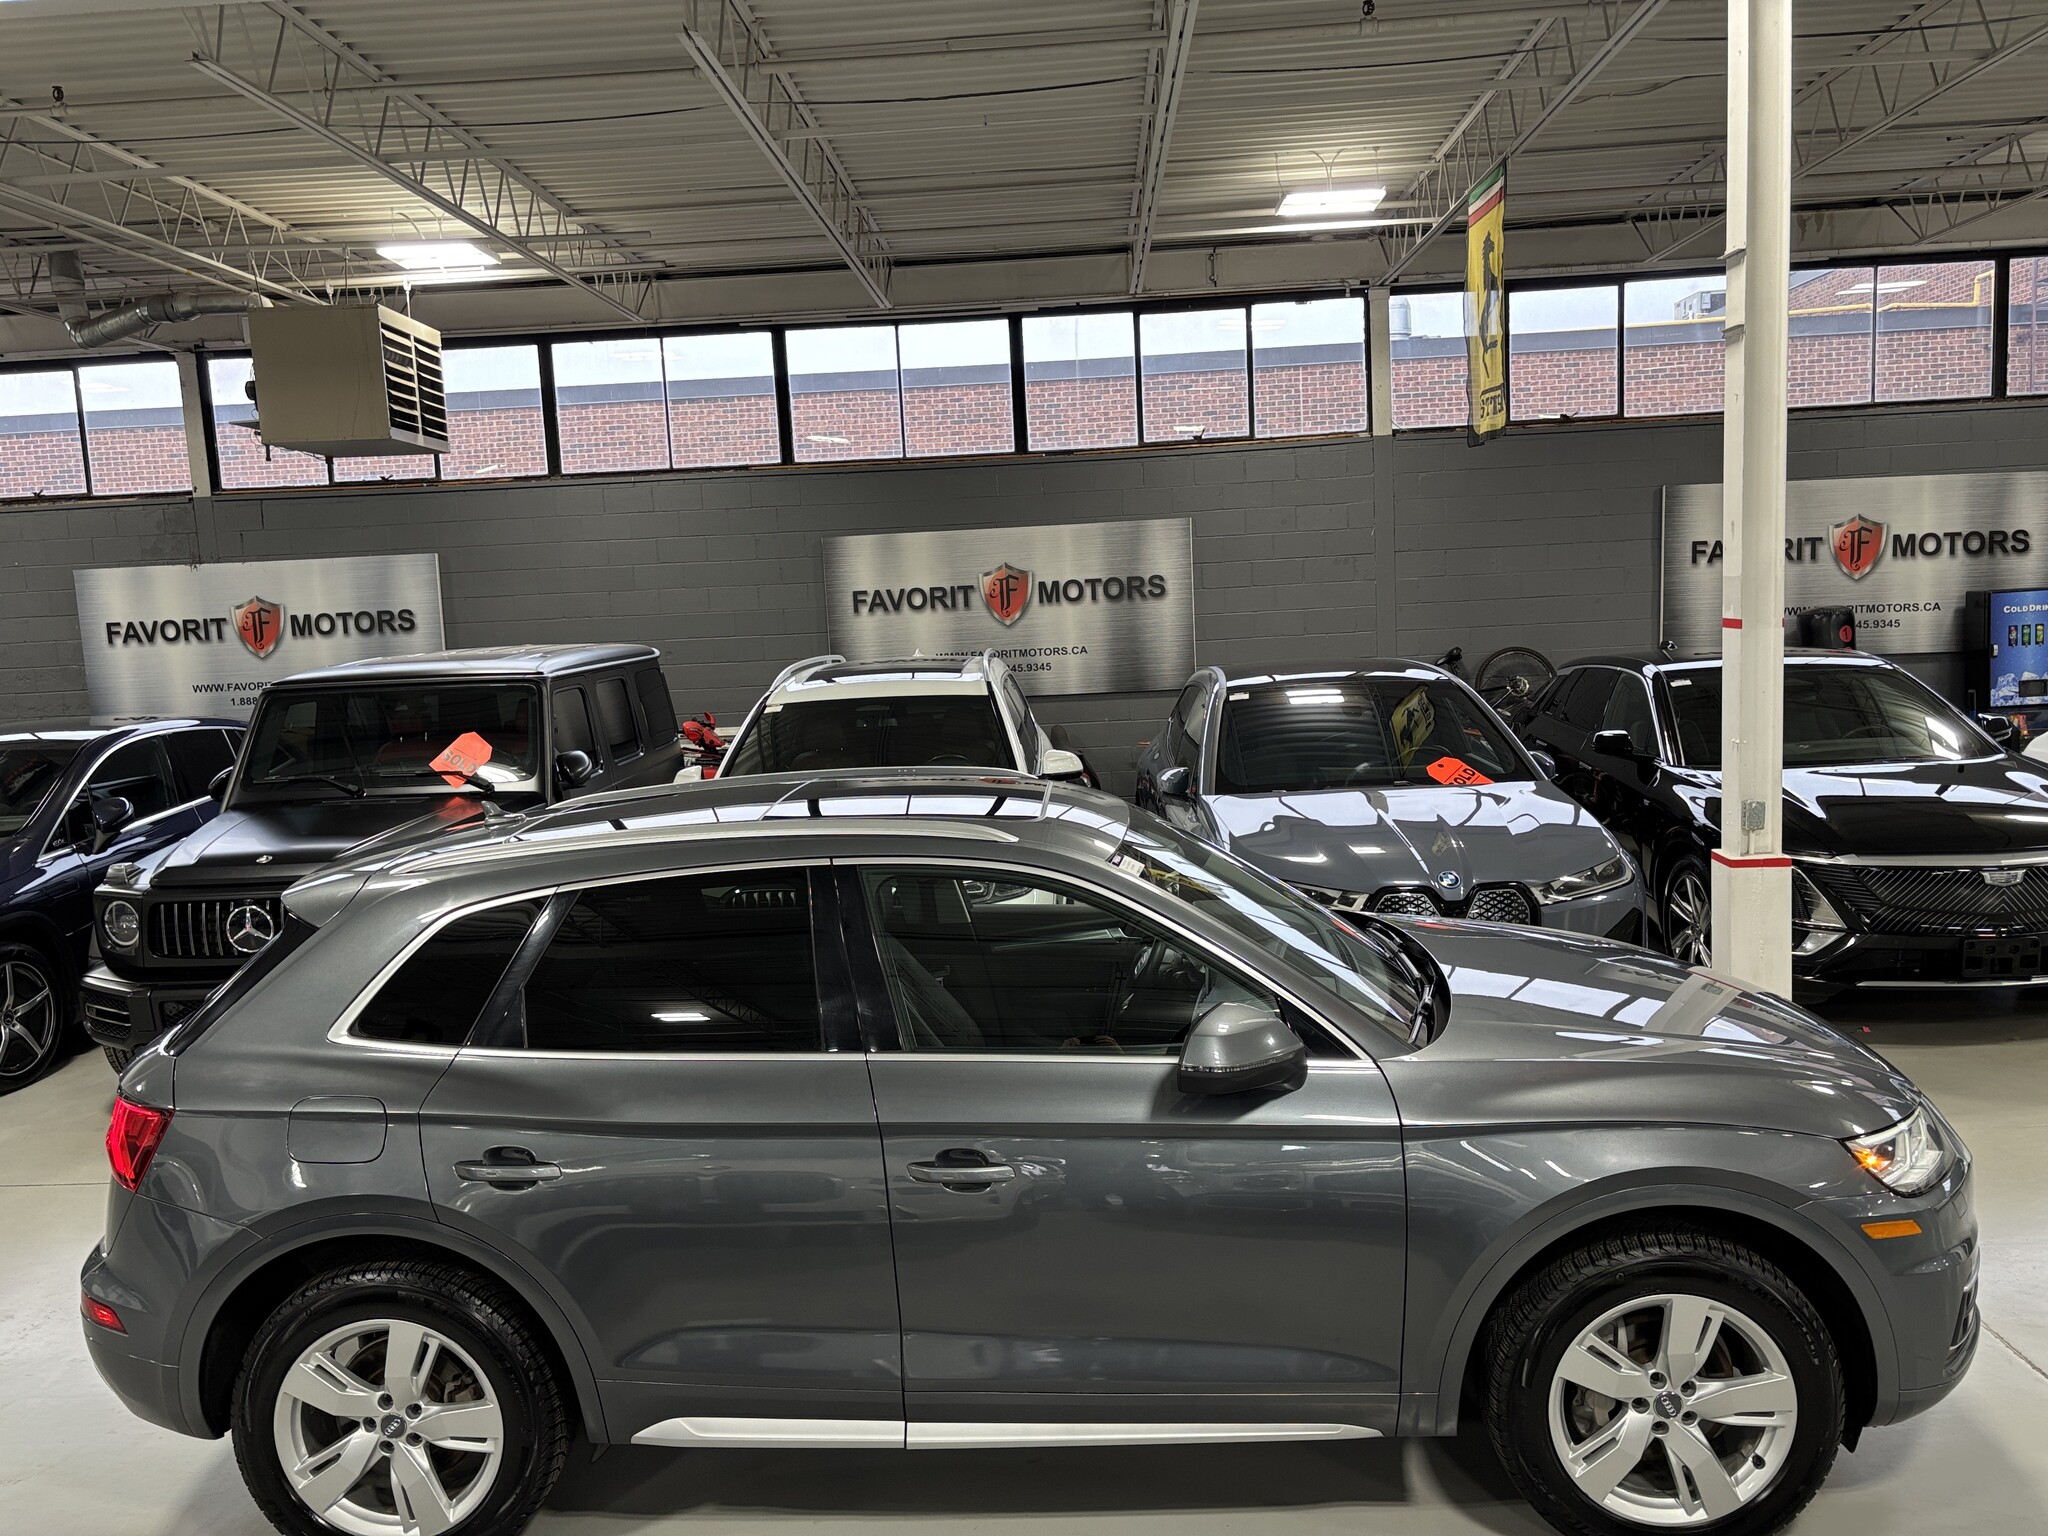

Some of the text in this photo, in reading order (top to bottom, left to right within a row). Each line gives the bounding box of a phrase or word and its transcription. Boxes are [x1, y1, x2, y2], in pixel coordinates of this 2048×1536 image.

[1691, 536, 1823, 564] FARIT
[1892, 528, 2031, 559] MOTORS
[852, 584, 975, 615] FAVORIT
[1037, 574, 1166, 604] MOTORS
[105, 617, 227, 645] FAVORIT
[289, 608, 416, 637] MOTORS
[443, 749, 477, 774] SOLD
[1448, 767, 1476, 785] OLD
